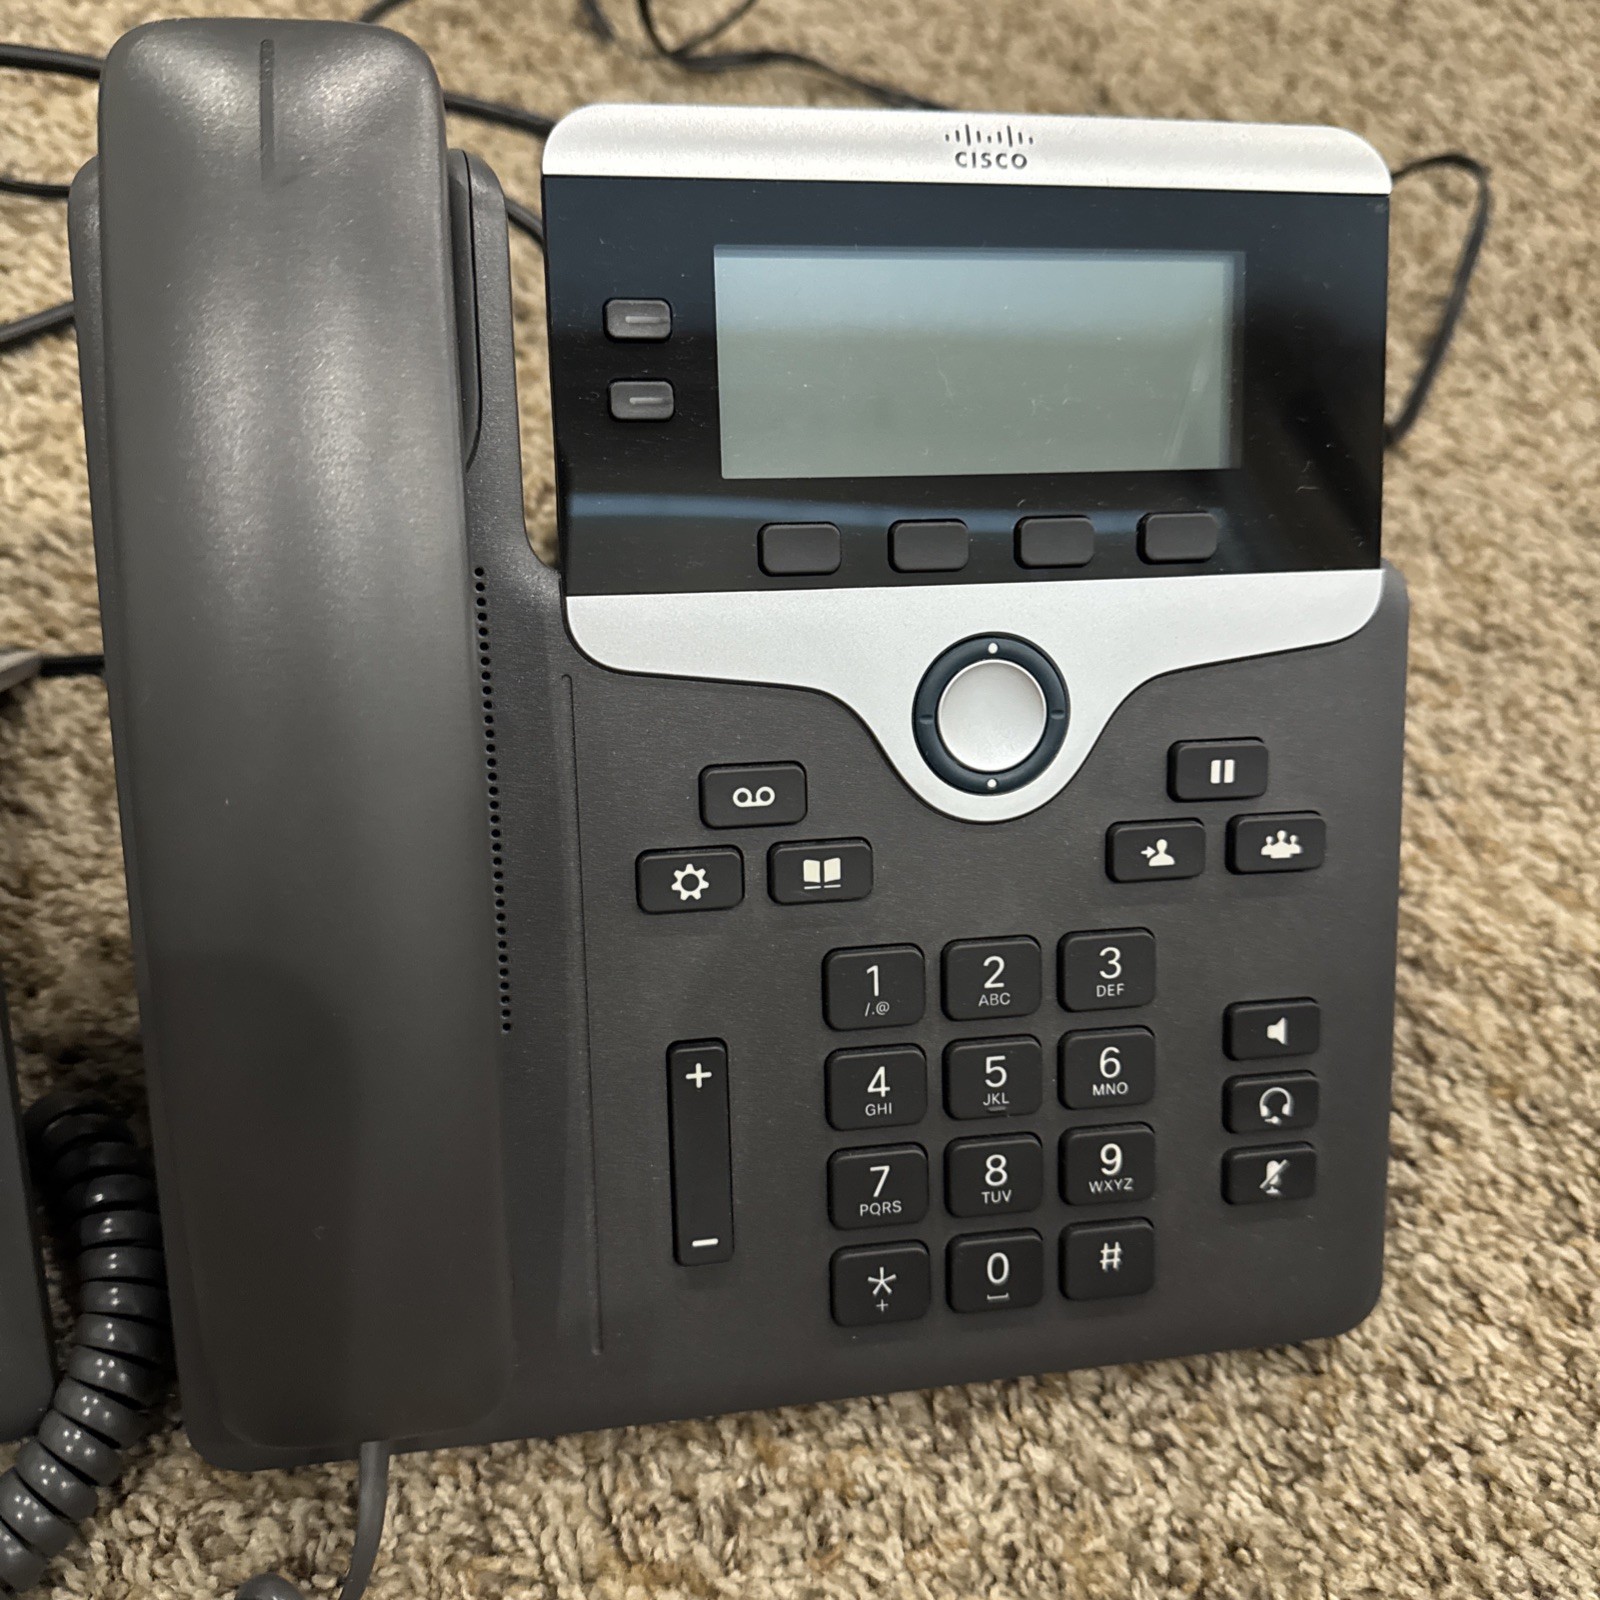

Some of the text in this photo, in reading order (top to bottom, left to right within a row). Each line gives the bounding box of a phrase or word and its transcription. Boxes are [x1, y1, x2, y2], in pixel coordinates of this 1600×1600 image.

[955, 151, 1027, 169] CISCO
[984, 956, 1004, 988] 2
[1100, 947, 1121, 979] 3
[867, 965, 879, 996] 1
[1097, 983, 1124, 997] DEF
[979, 993, 1010, 1006] ABC
[986, 1056, 1007, 1087] 5
[1100, 1047, 1120, 1078] 6
[868, 1066, 890, 1097] 4
[1093, 1082, 1128, 1095] MNO
[865, 1103, 892, 1116] GHI
[983, 1093, 1009, 1105] JKL
[985, 1155, 1007, 1186] 8
[1101, 1144, 1121, 1175] 9
[870, 1166, 889, 1197] 7
[982, 1190, 1011, 1203] TUV
[1089, 1178, 1132, 1193] WXYZ
[860, 1200, 901, 1216] PQRS
[987, 1253, 1009, 1284] 0
